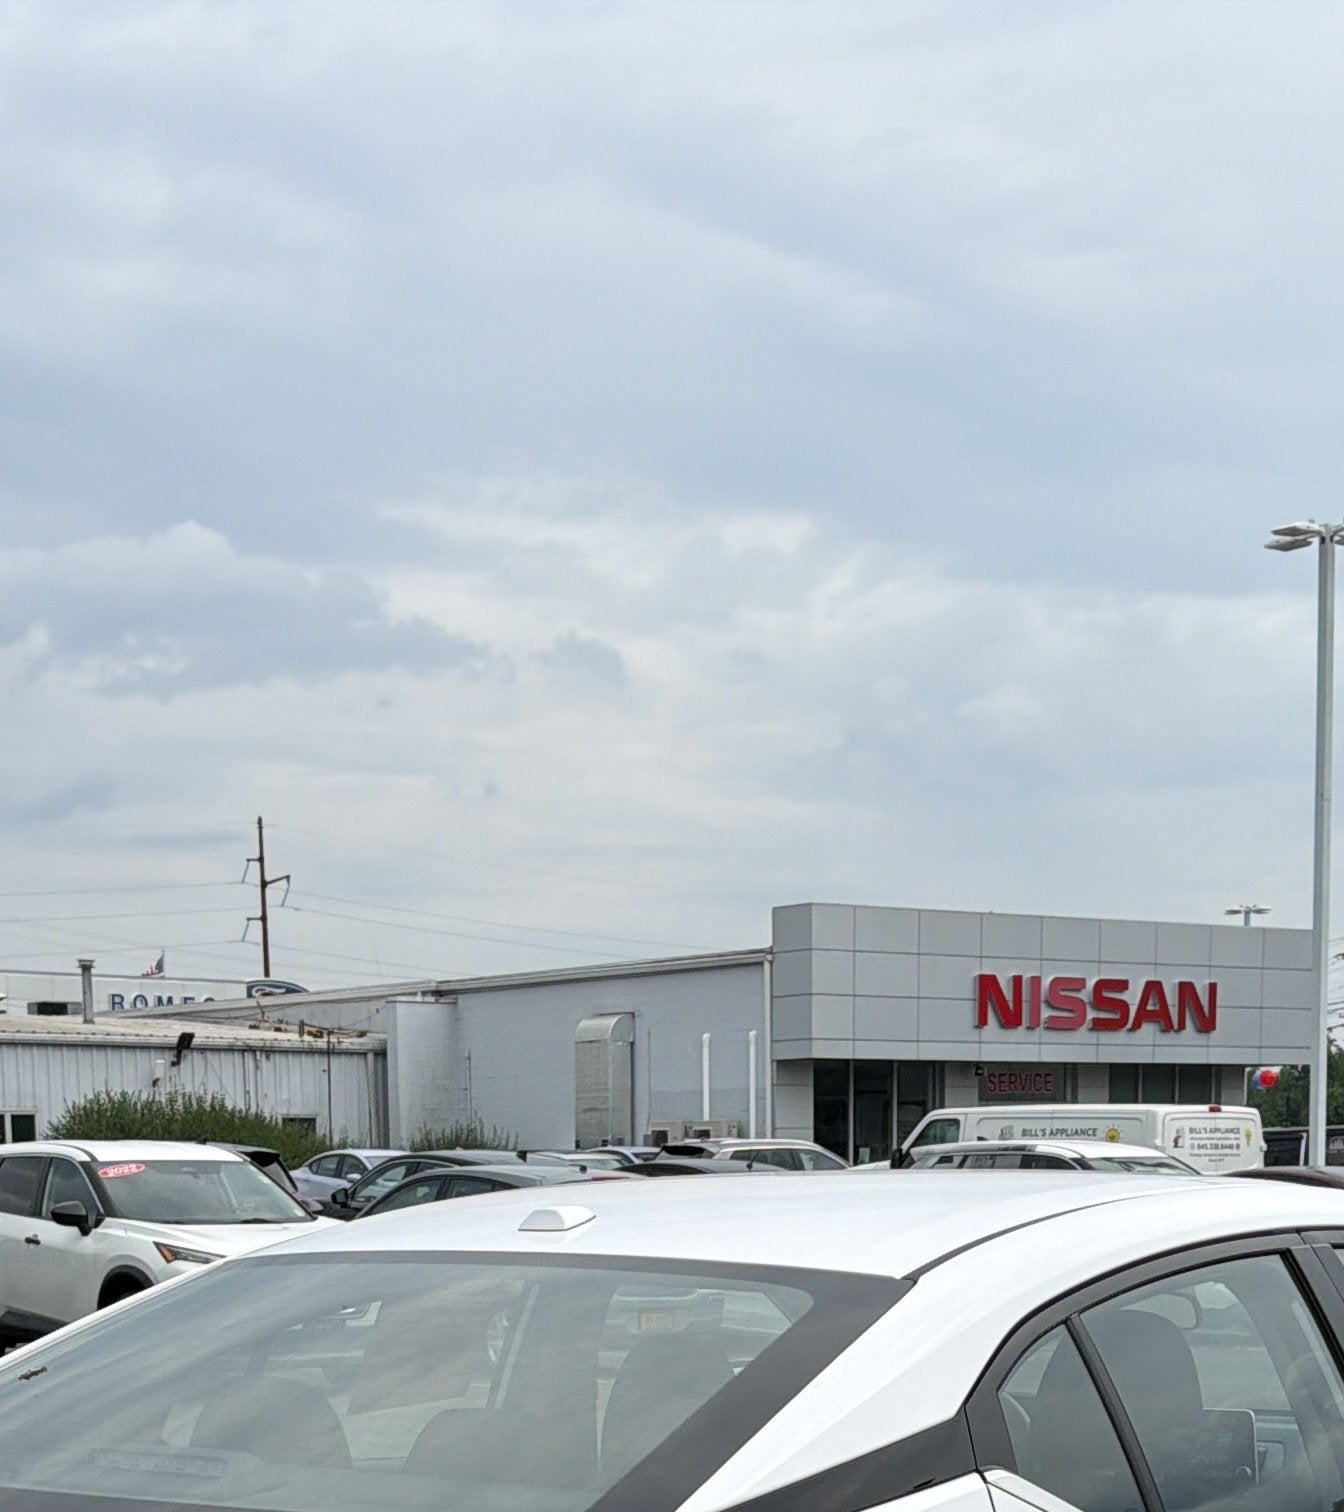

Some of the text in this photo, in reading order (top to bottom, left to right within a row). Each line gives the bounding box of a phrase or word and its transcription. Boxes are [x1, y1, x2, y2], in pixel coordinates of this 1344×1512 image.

[975, 974, 1218, 1033] NISSAN
[987, 1071, 1053, 1093] SERVICE
[1021, 1128, 1098, 1137] BILL'S APPLIANCE
